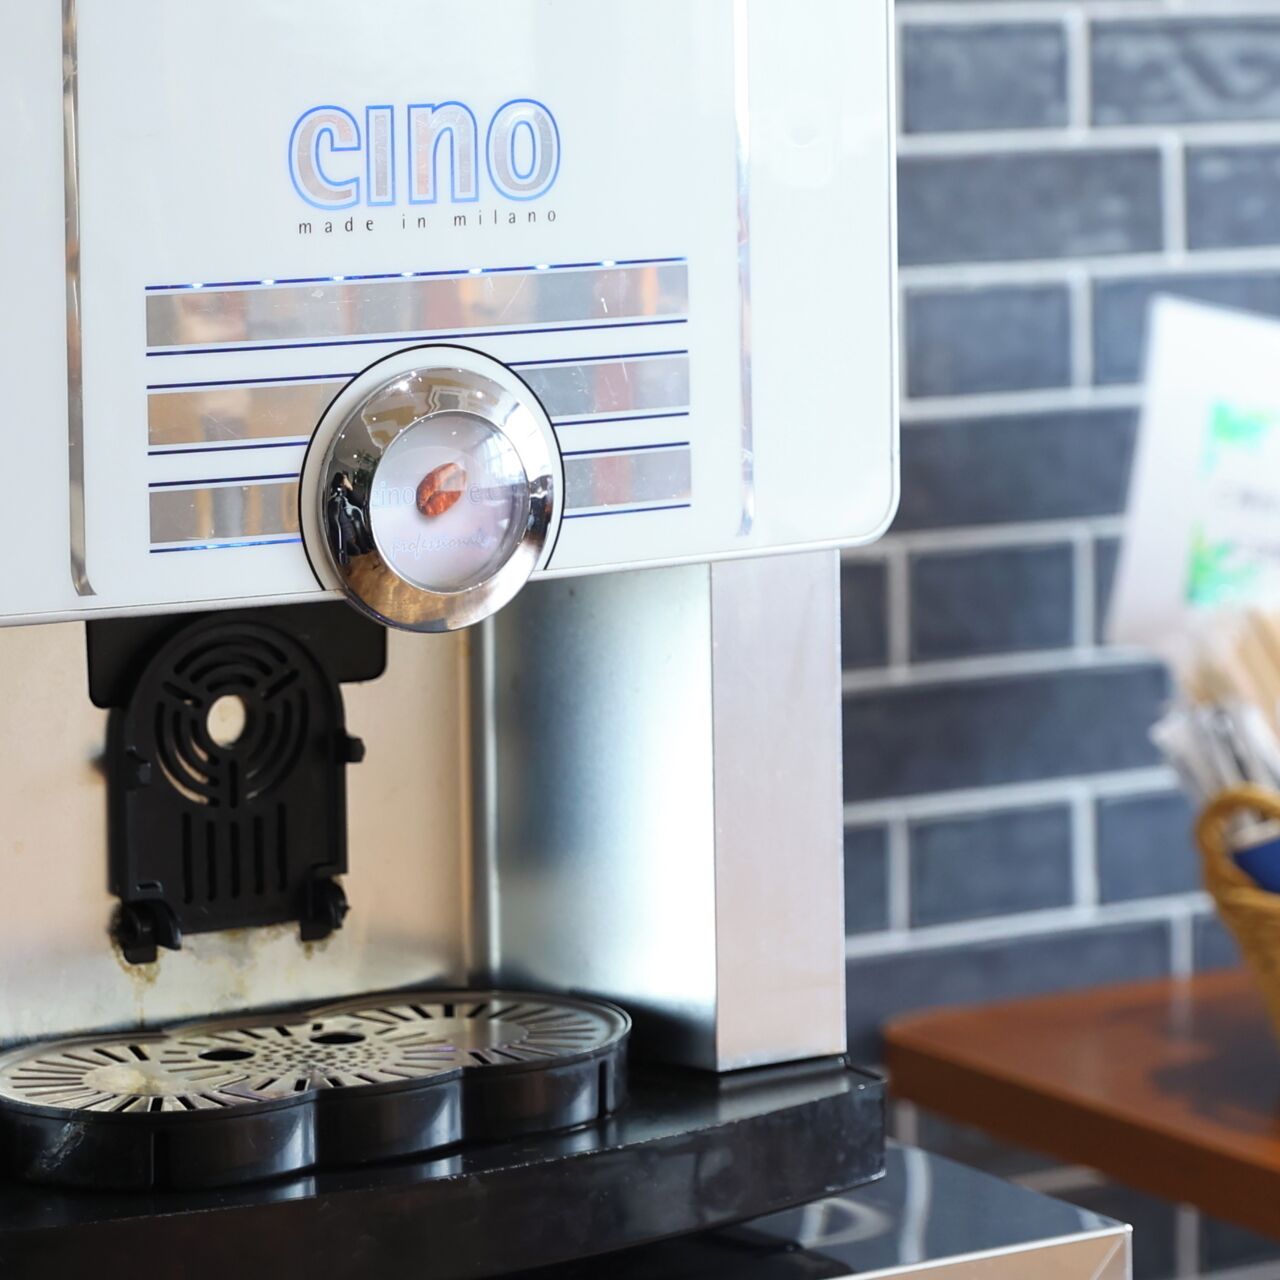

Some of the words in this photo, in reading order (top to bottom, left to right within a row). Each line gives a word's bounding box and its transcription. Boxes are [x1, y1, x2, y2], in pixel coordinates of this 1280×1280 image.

[287, 98, 561, 211] cino
[298, 215, 375, 236] made
[401, 213, 427, 230] in
[453, 208, 557, 227] milano
